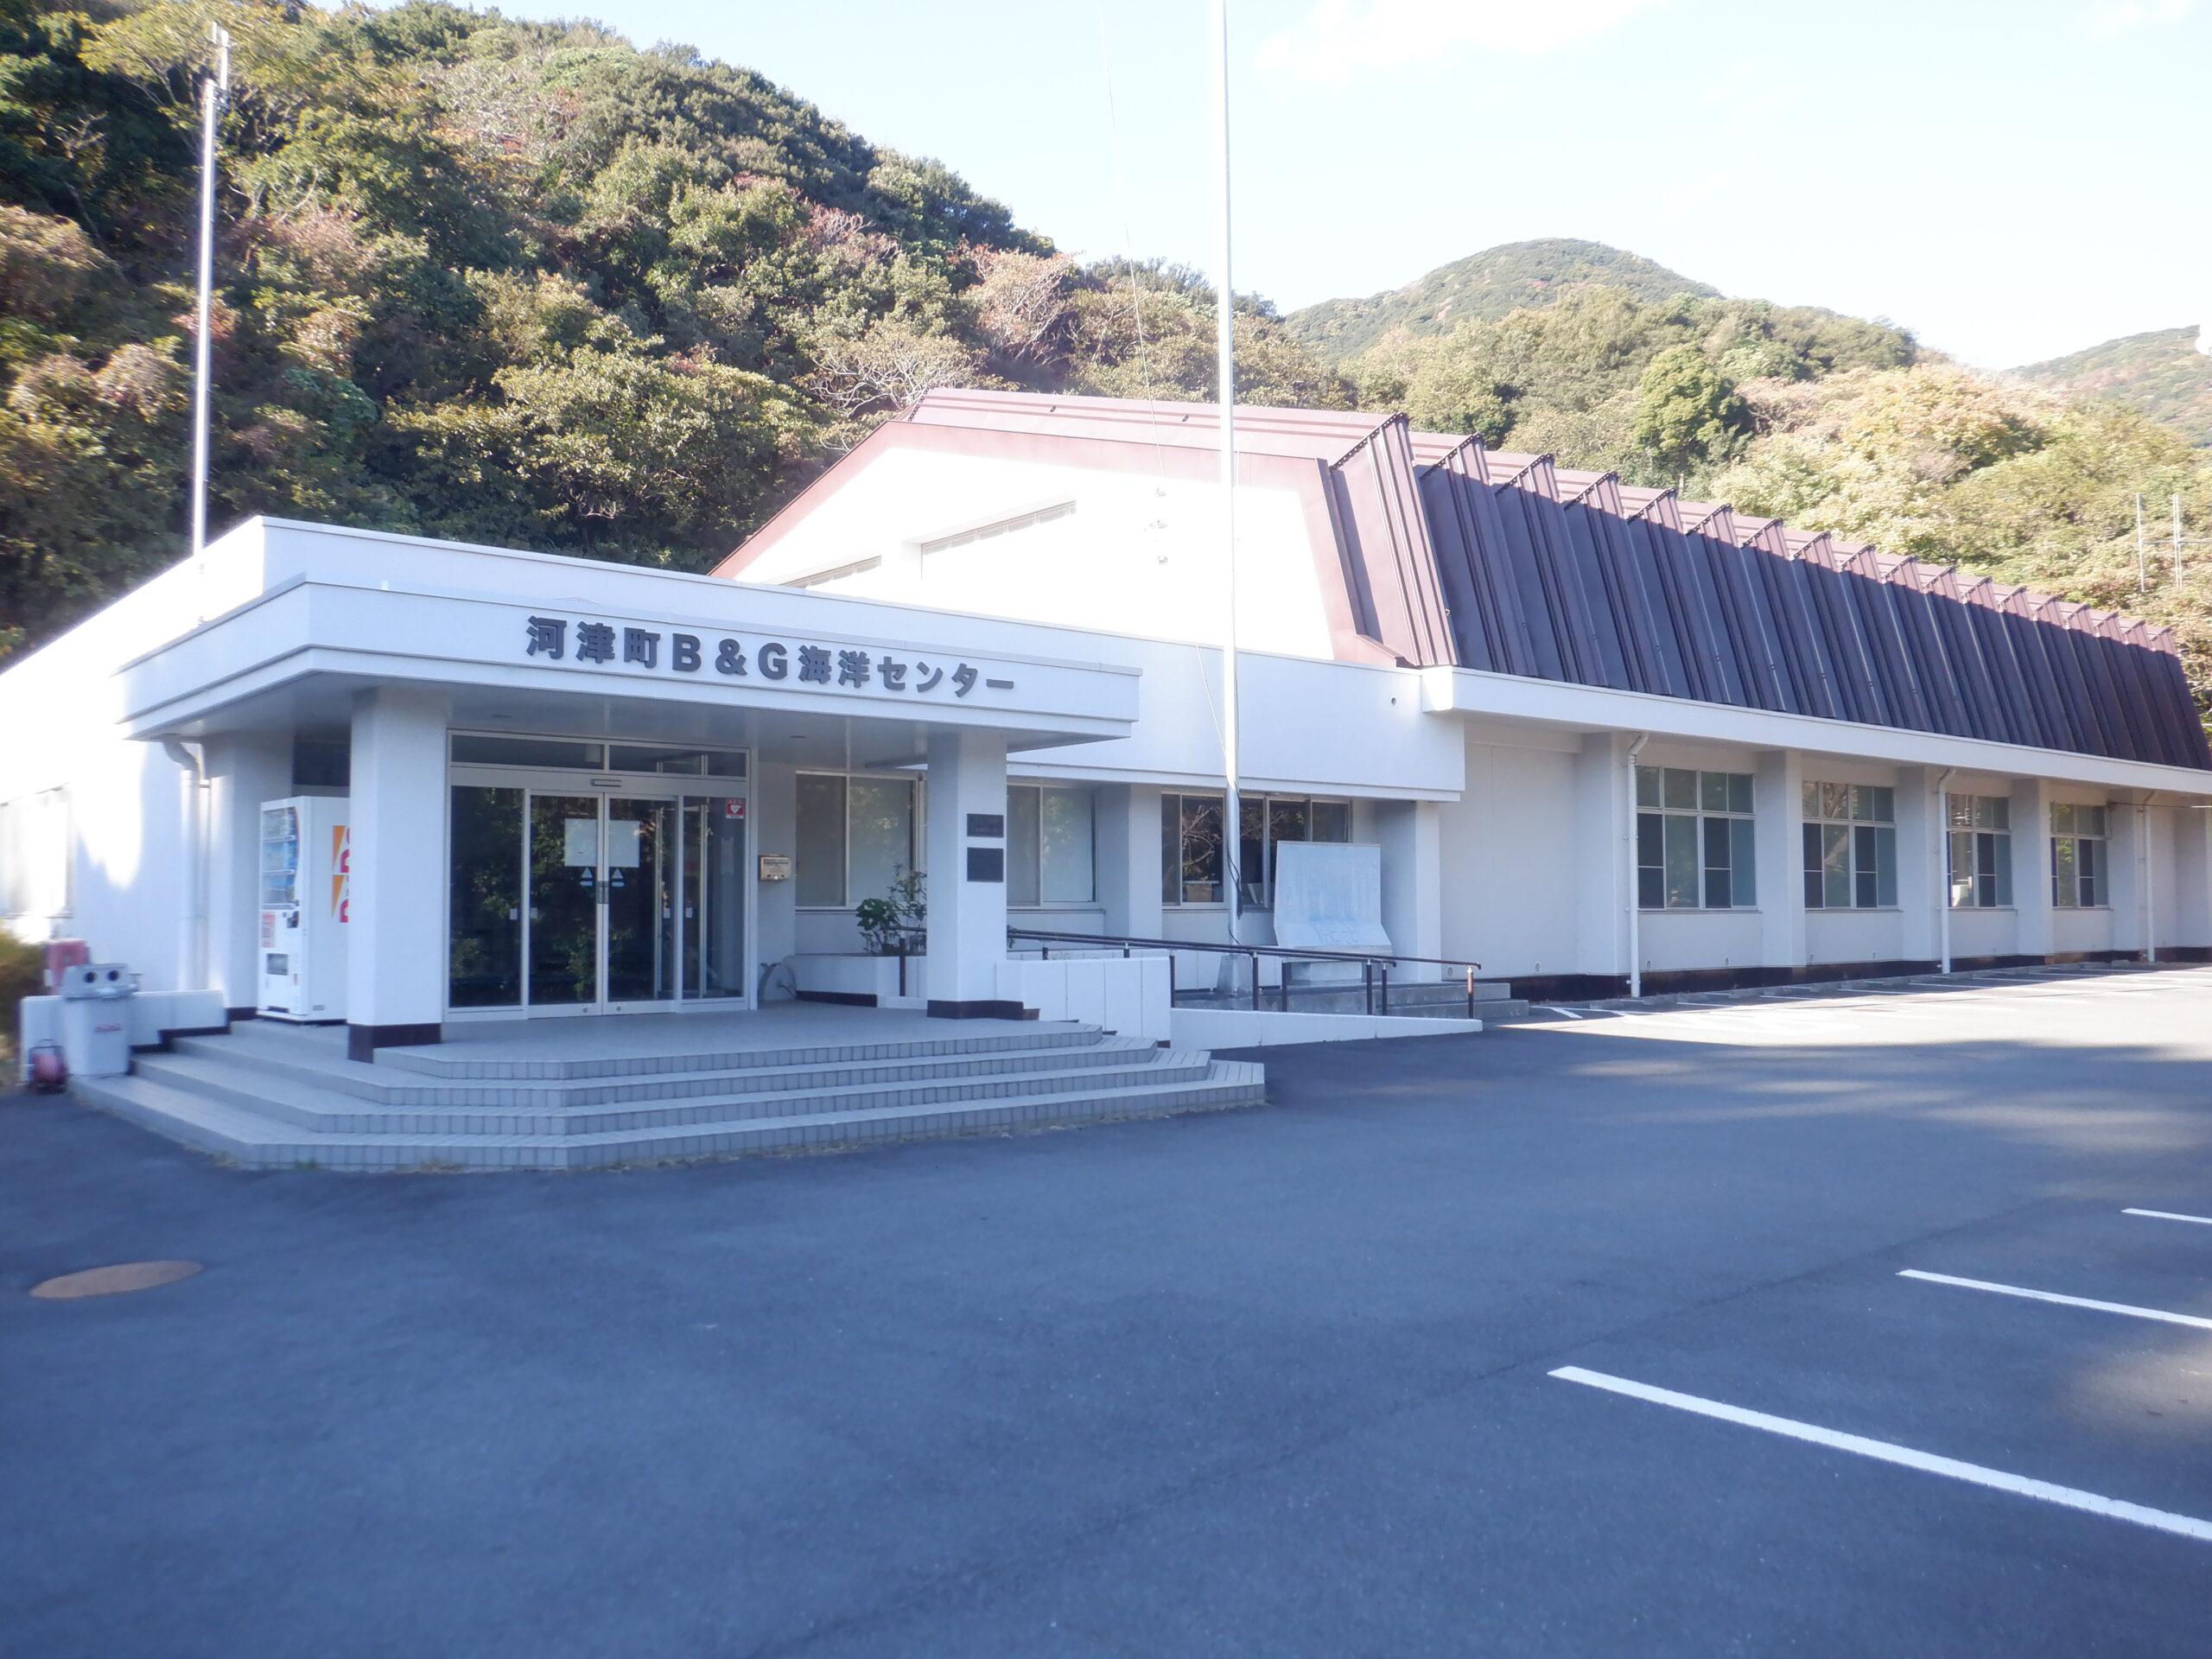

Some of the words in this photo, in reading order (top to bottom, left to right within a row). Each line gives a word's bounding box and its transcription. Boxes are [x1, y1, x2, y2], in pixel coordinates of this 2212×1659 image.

[525, 615, 1014, 698] 河津町B&G海洋センター
